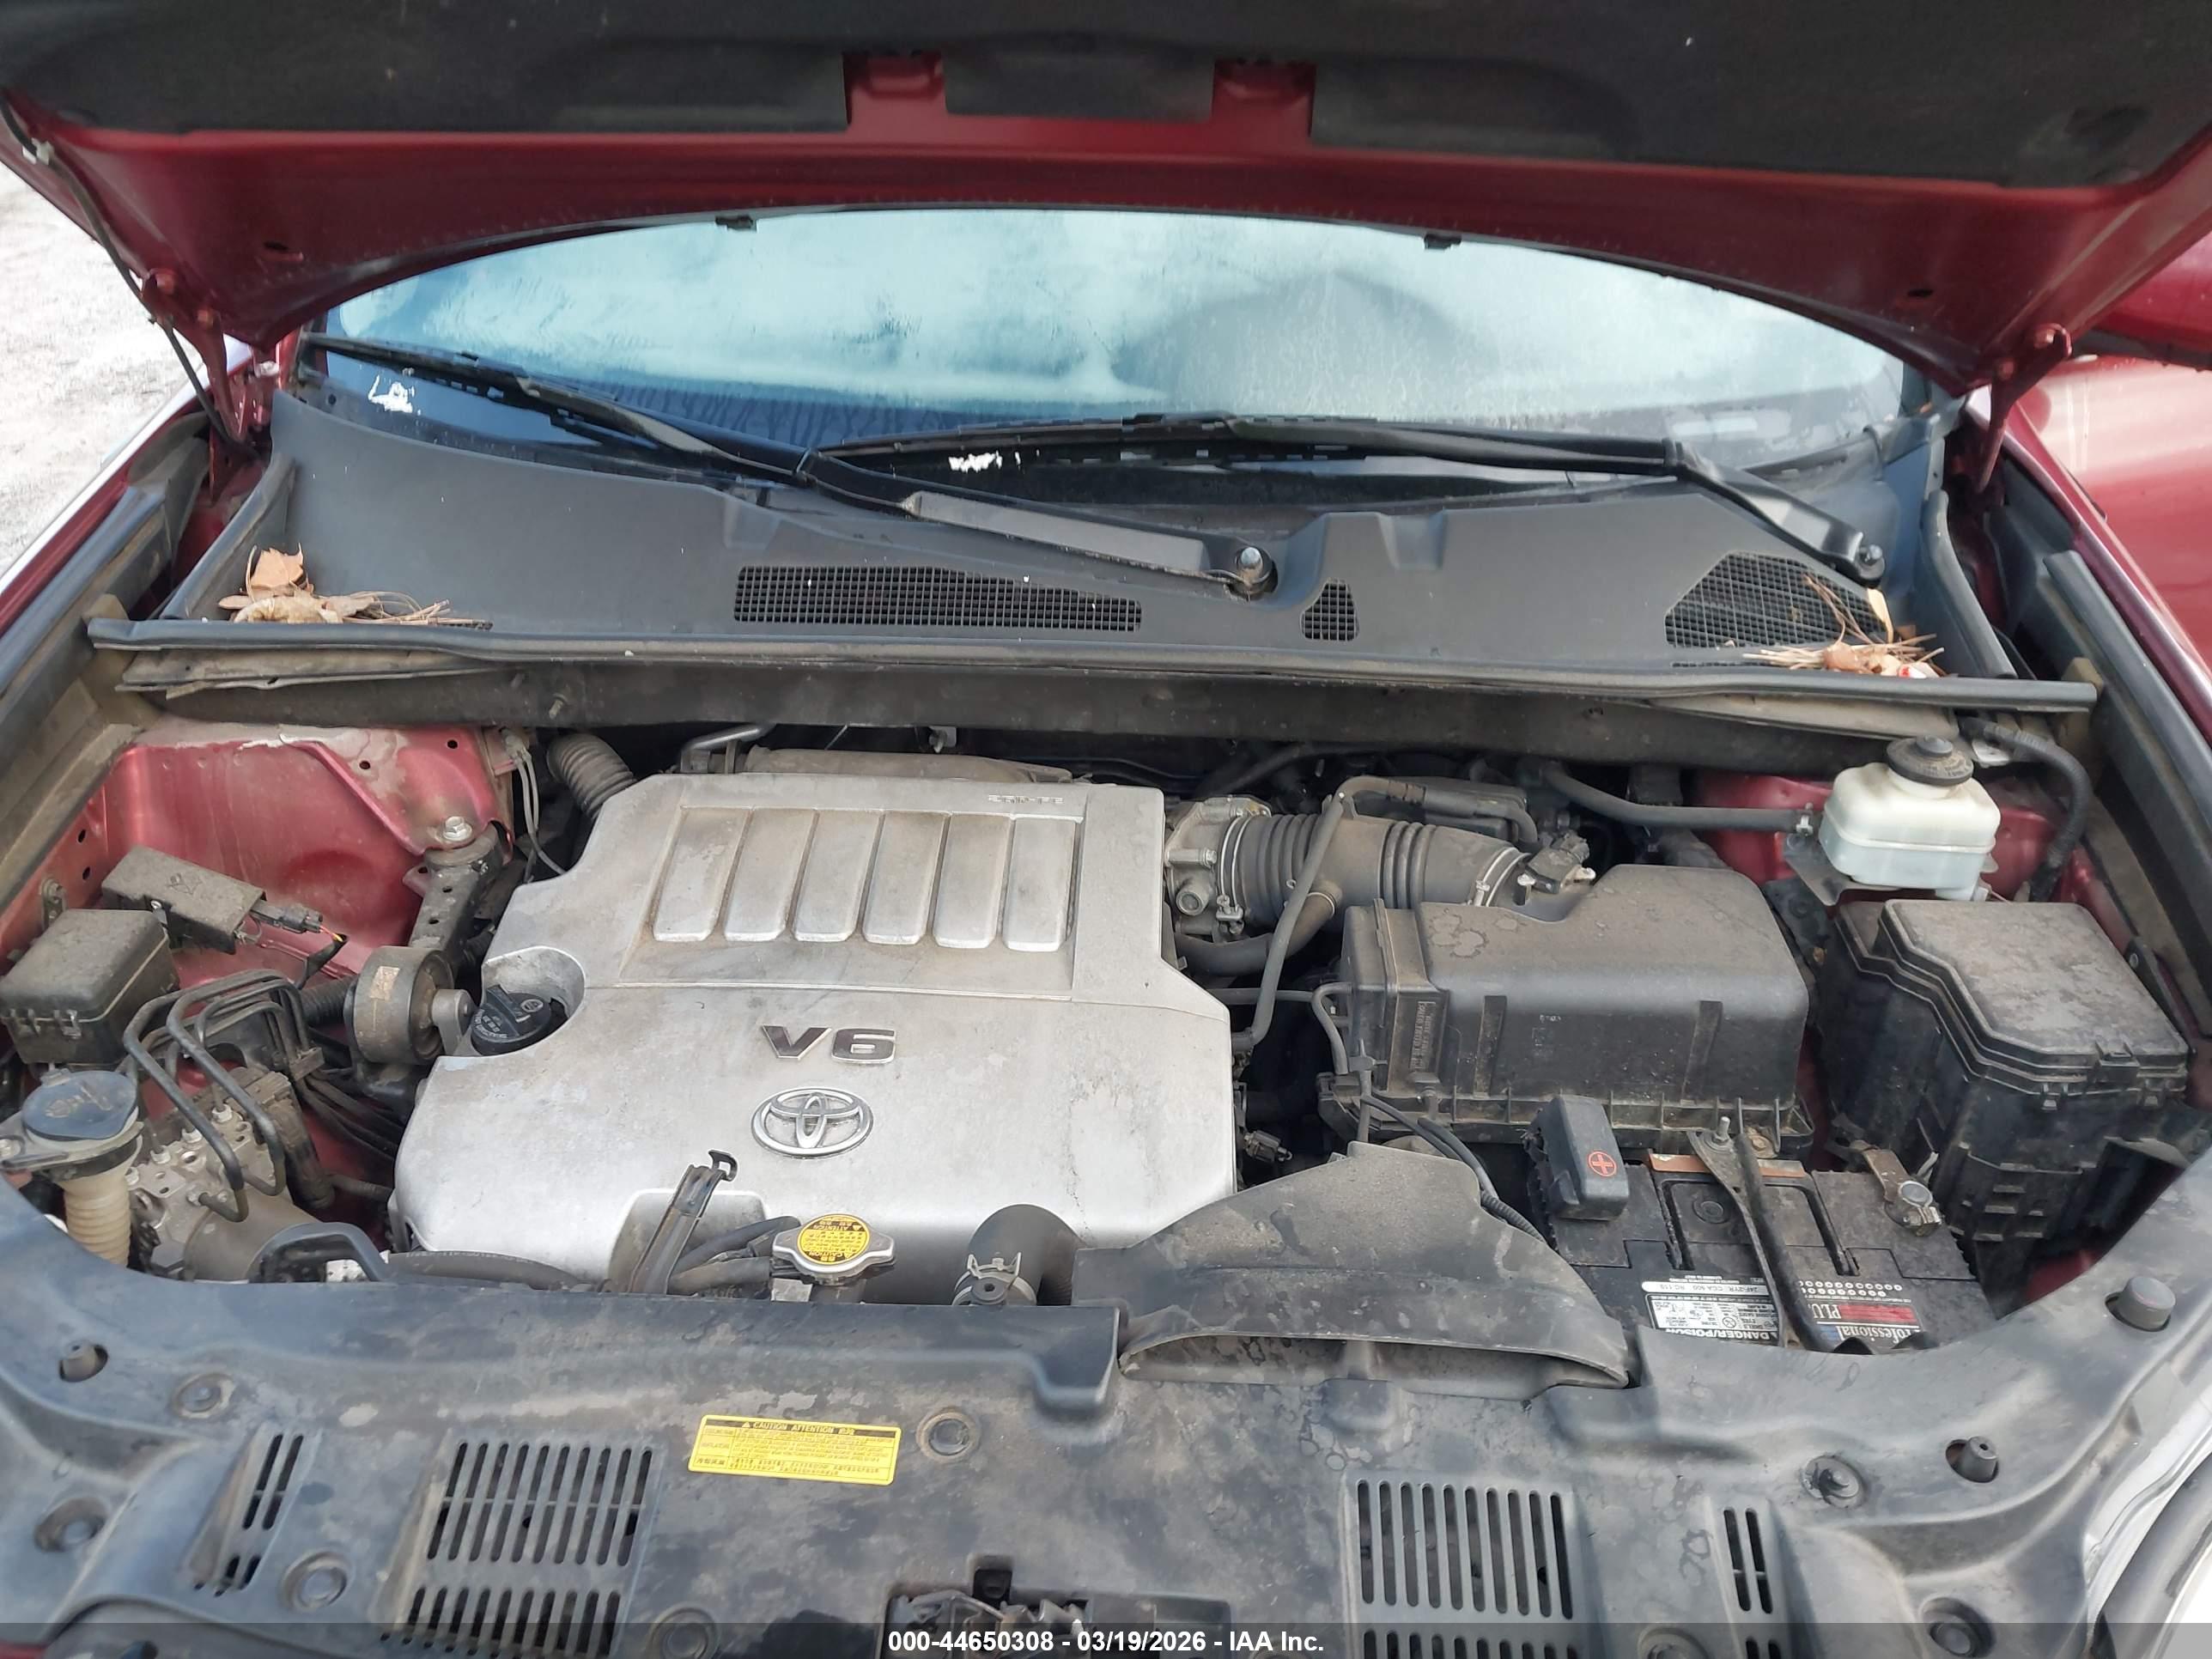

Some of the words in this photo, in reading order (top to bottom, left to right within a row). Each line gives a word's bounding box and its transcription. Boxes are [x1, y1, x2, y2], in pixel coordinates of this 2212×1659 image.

[761, 1024, 896, 1065] V6
[1808, 1303, 1842, 1319] PLU
[1835, 1326, 1921, 1344] rofessional
[752, 1421, 787, 1430] CAUTION
[791, 1424, 835, 1433] ATTENTION
